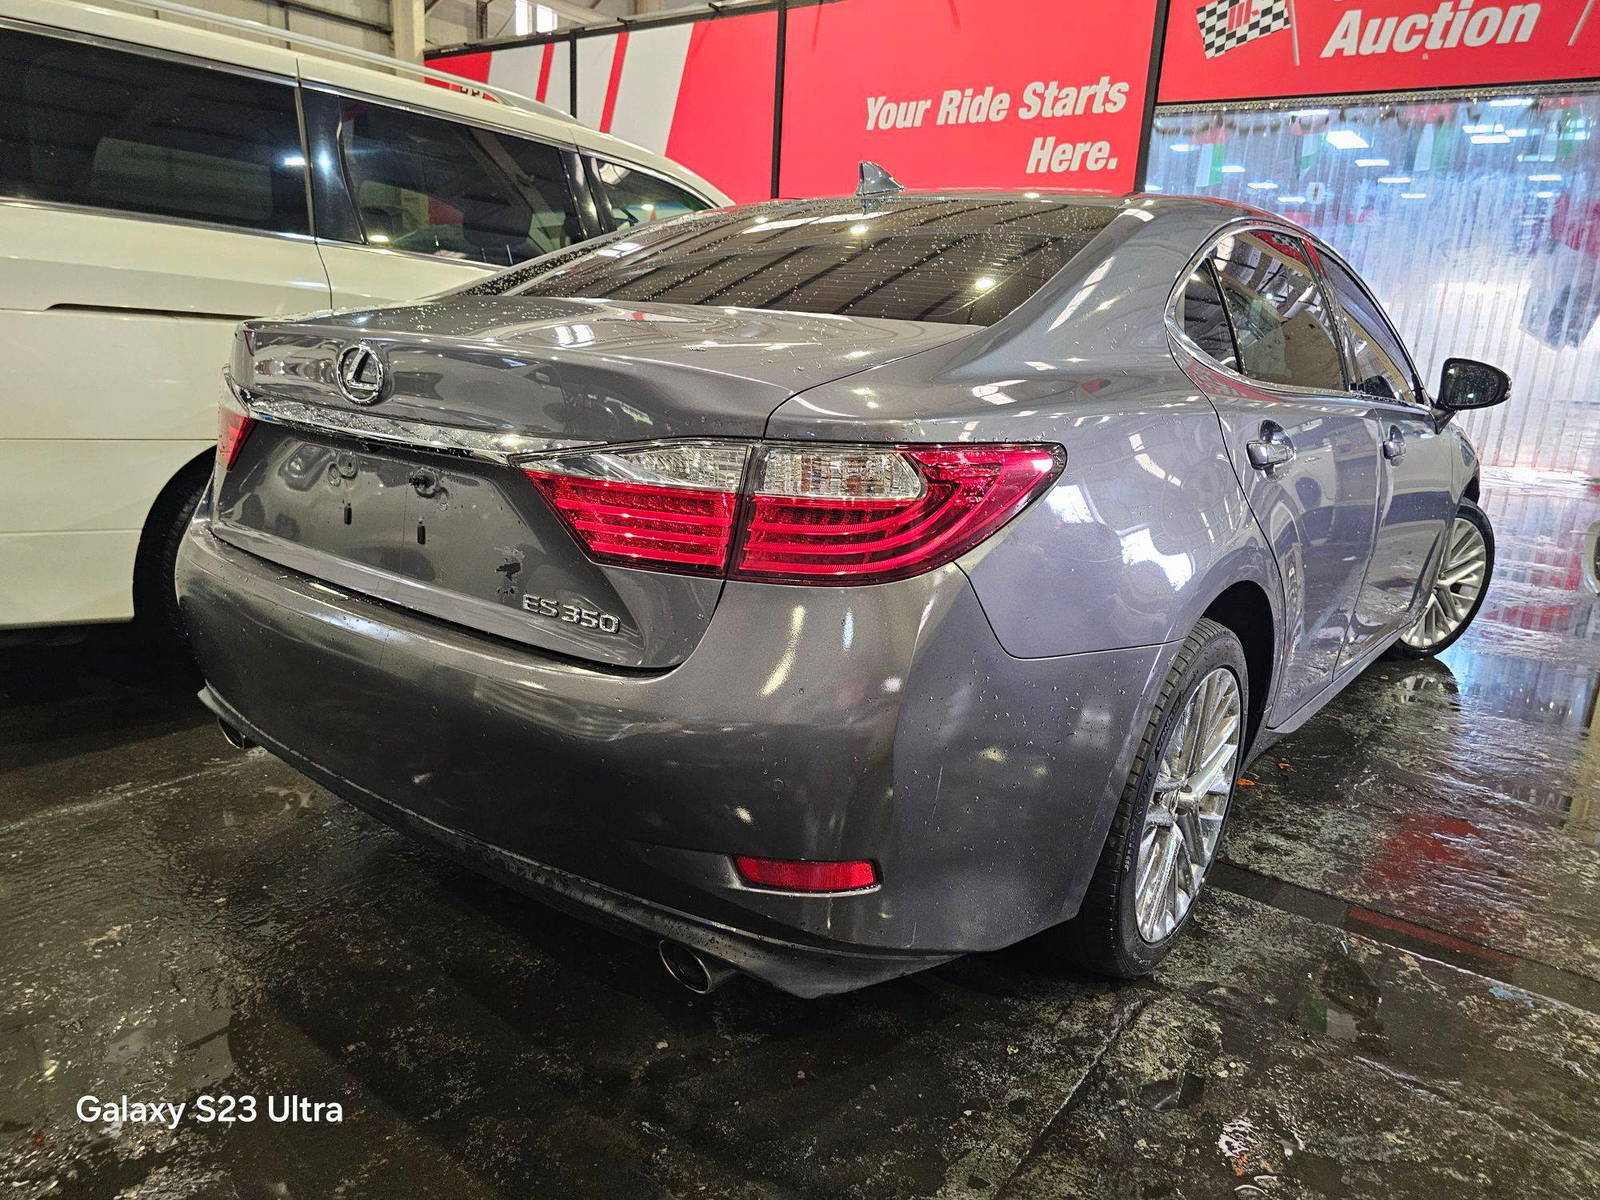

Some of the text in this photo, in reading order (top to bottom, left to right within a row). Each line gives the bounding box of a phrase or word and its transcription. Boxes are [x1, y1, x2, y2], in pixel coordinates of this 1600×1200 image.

[1320, 0, 1541, 59] Auction
[865, 76, 1130, 131] Your Ride Starts
[1025, 136, 1119, 174] Here.
[522, 593, 621, 634] ES 350
